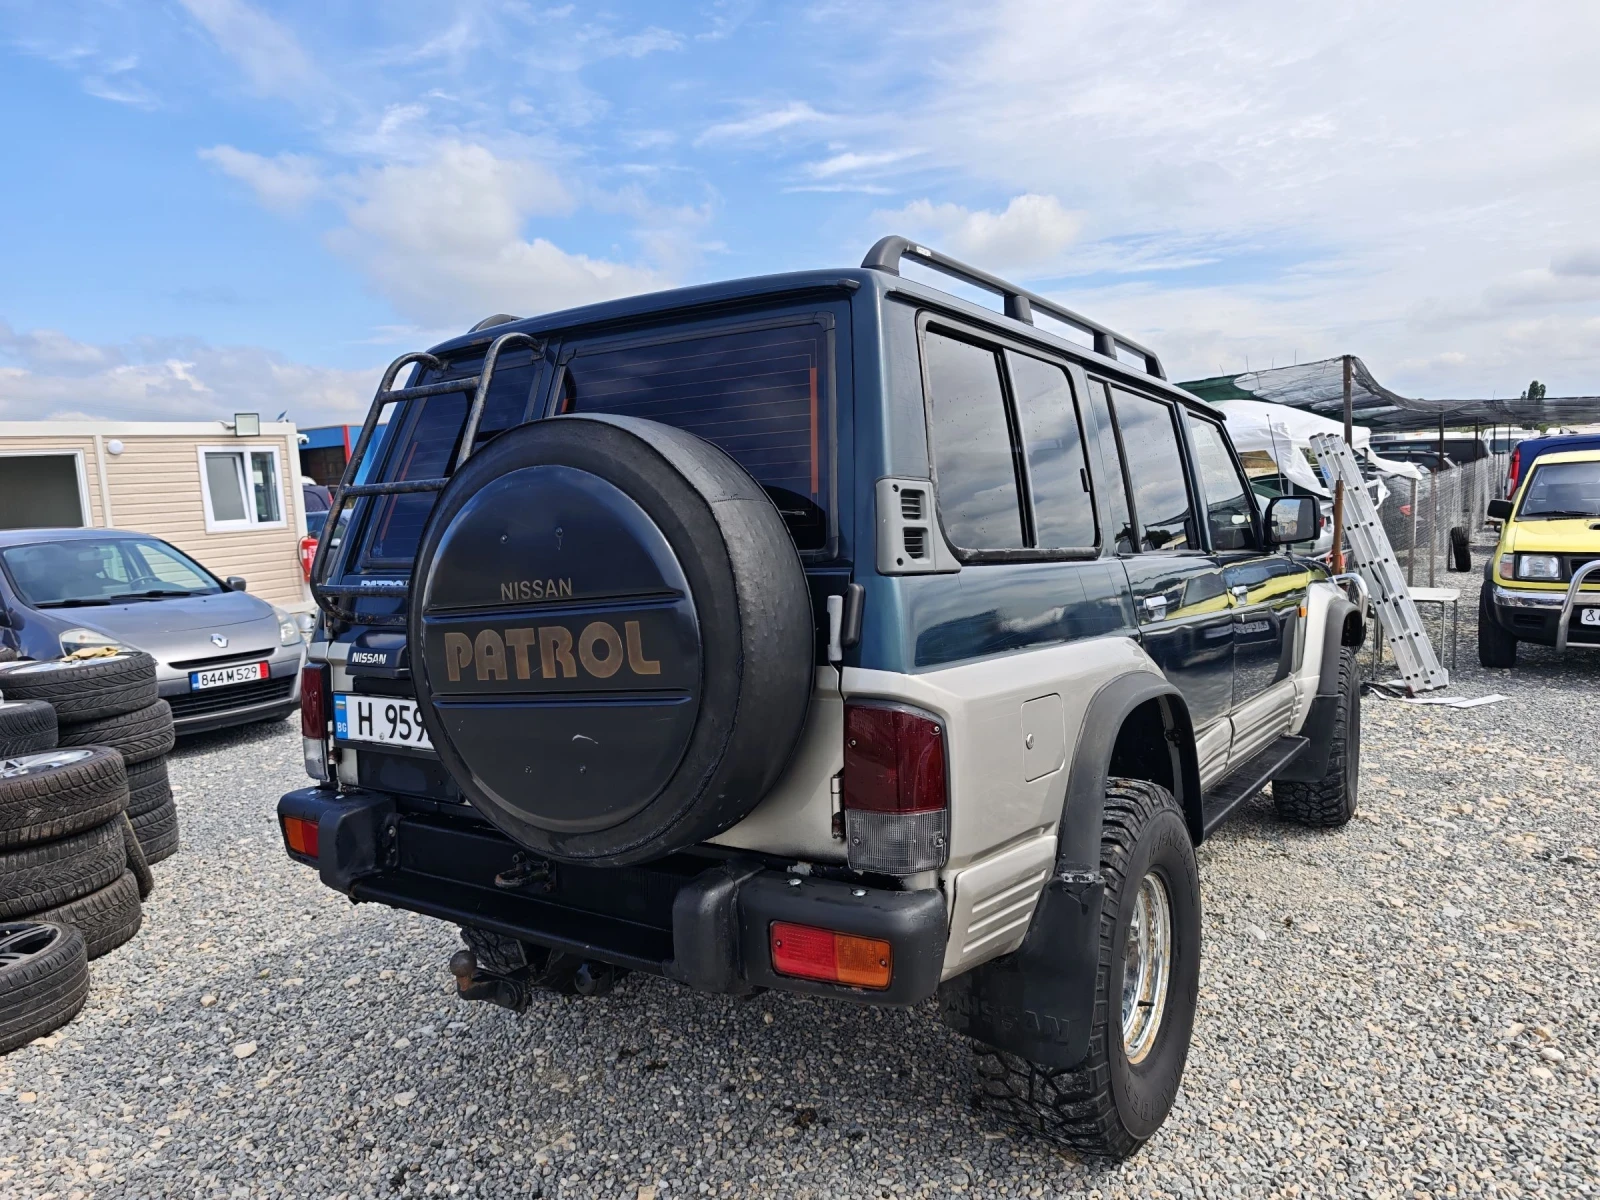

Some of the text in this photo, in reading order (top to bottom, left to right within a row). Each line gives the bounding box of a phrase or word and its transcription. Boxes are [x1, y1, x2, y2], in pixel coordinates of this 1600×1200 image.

[501, 577, 573, 600] NISSAN
[352, 652, 387, 665] NISSAN
[444, 620, 661, 682] PATROL
[337, 721, 347, 732] BG
[385, 703, 428, 742] 959
